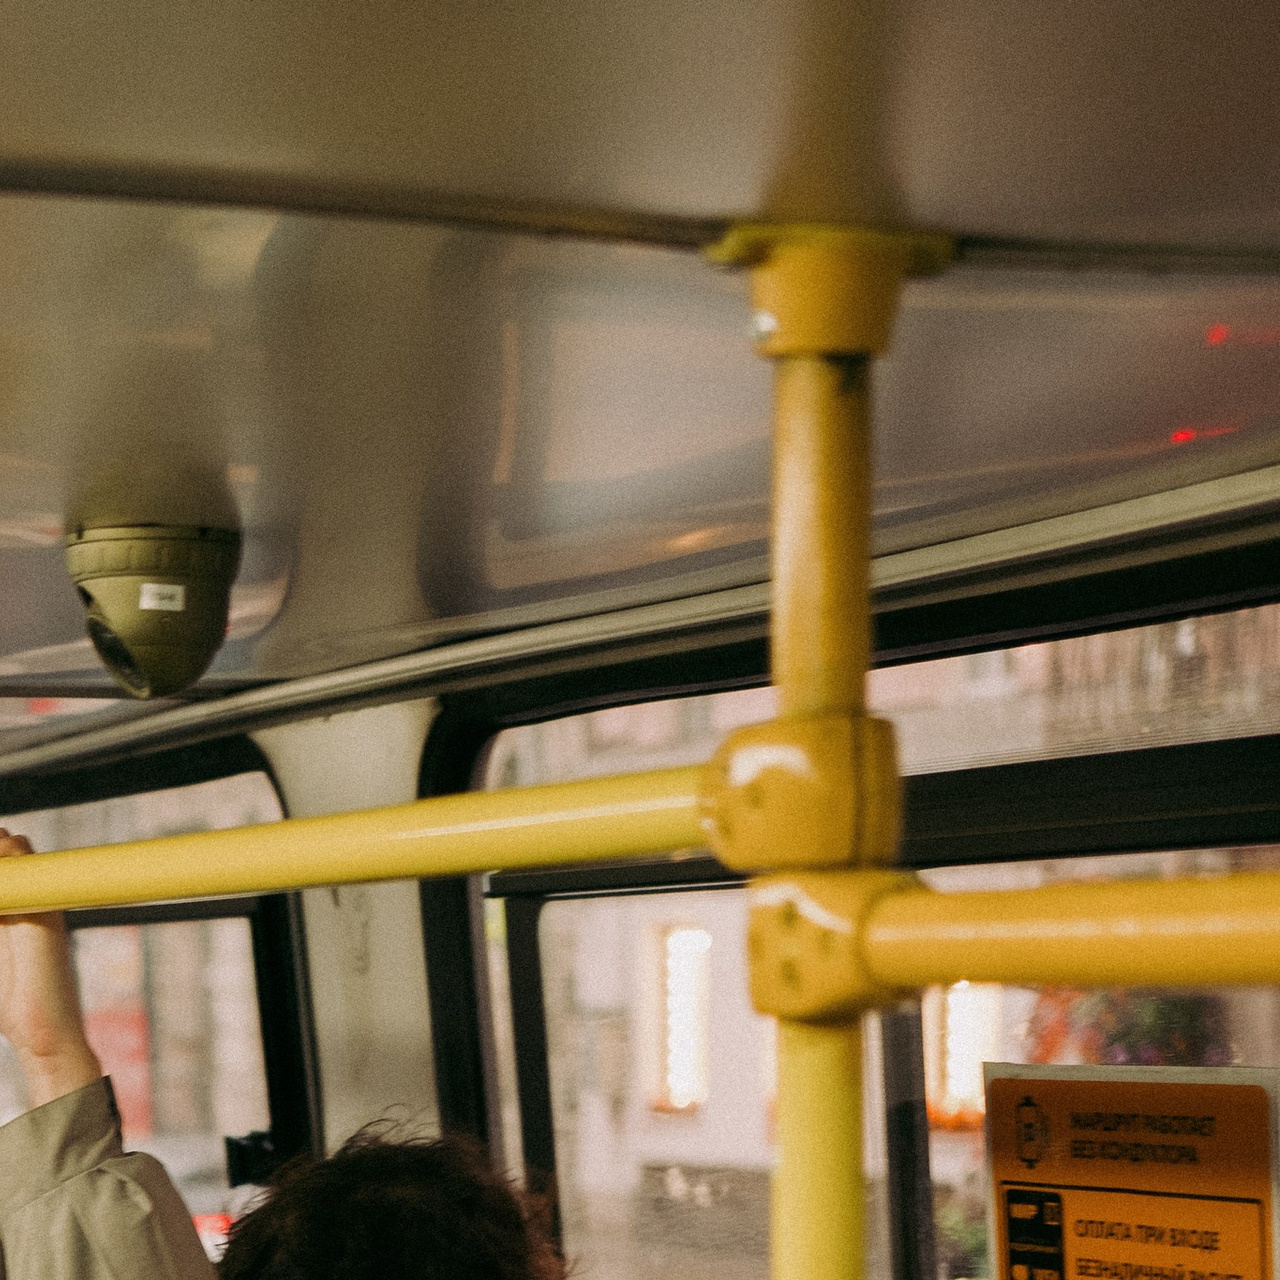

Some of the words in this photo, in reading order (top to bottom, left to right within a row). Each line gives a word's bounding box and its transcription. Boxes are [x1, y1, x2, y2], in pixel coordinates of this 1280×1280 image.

[1073, 1218, 1132, 1241] ОПЛАТА
[1136, 1224, 1166, 1245] ПРИ
[1169, 1228, 1221, 1251] ВХОДЕ
